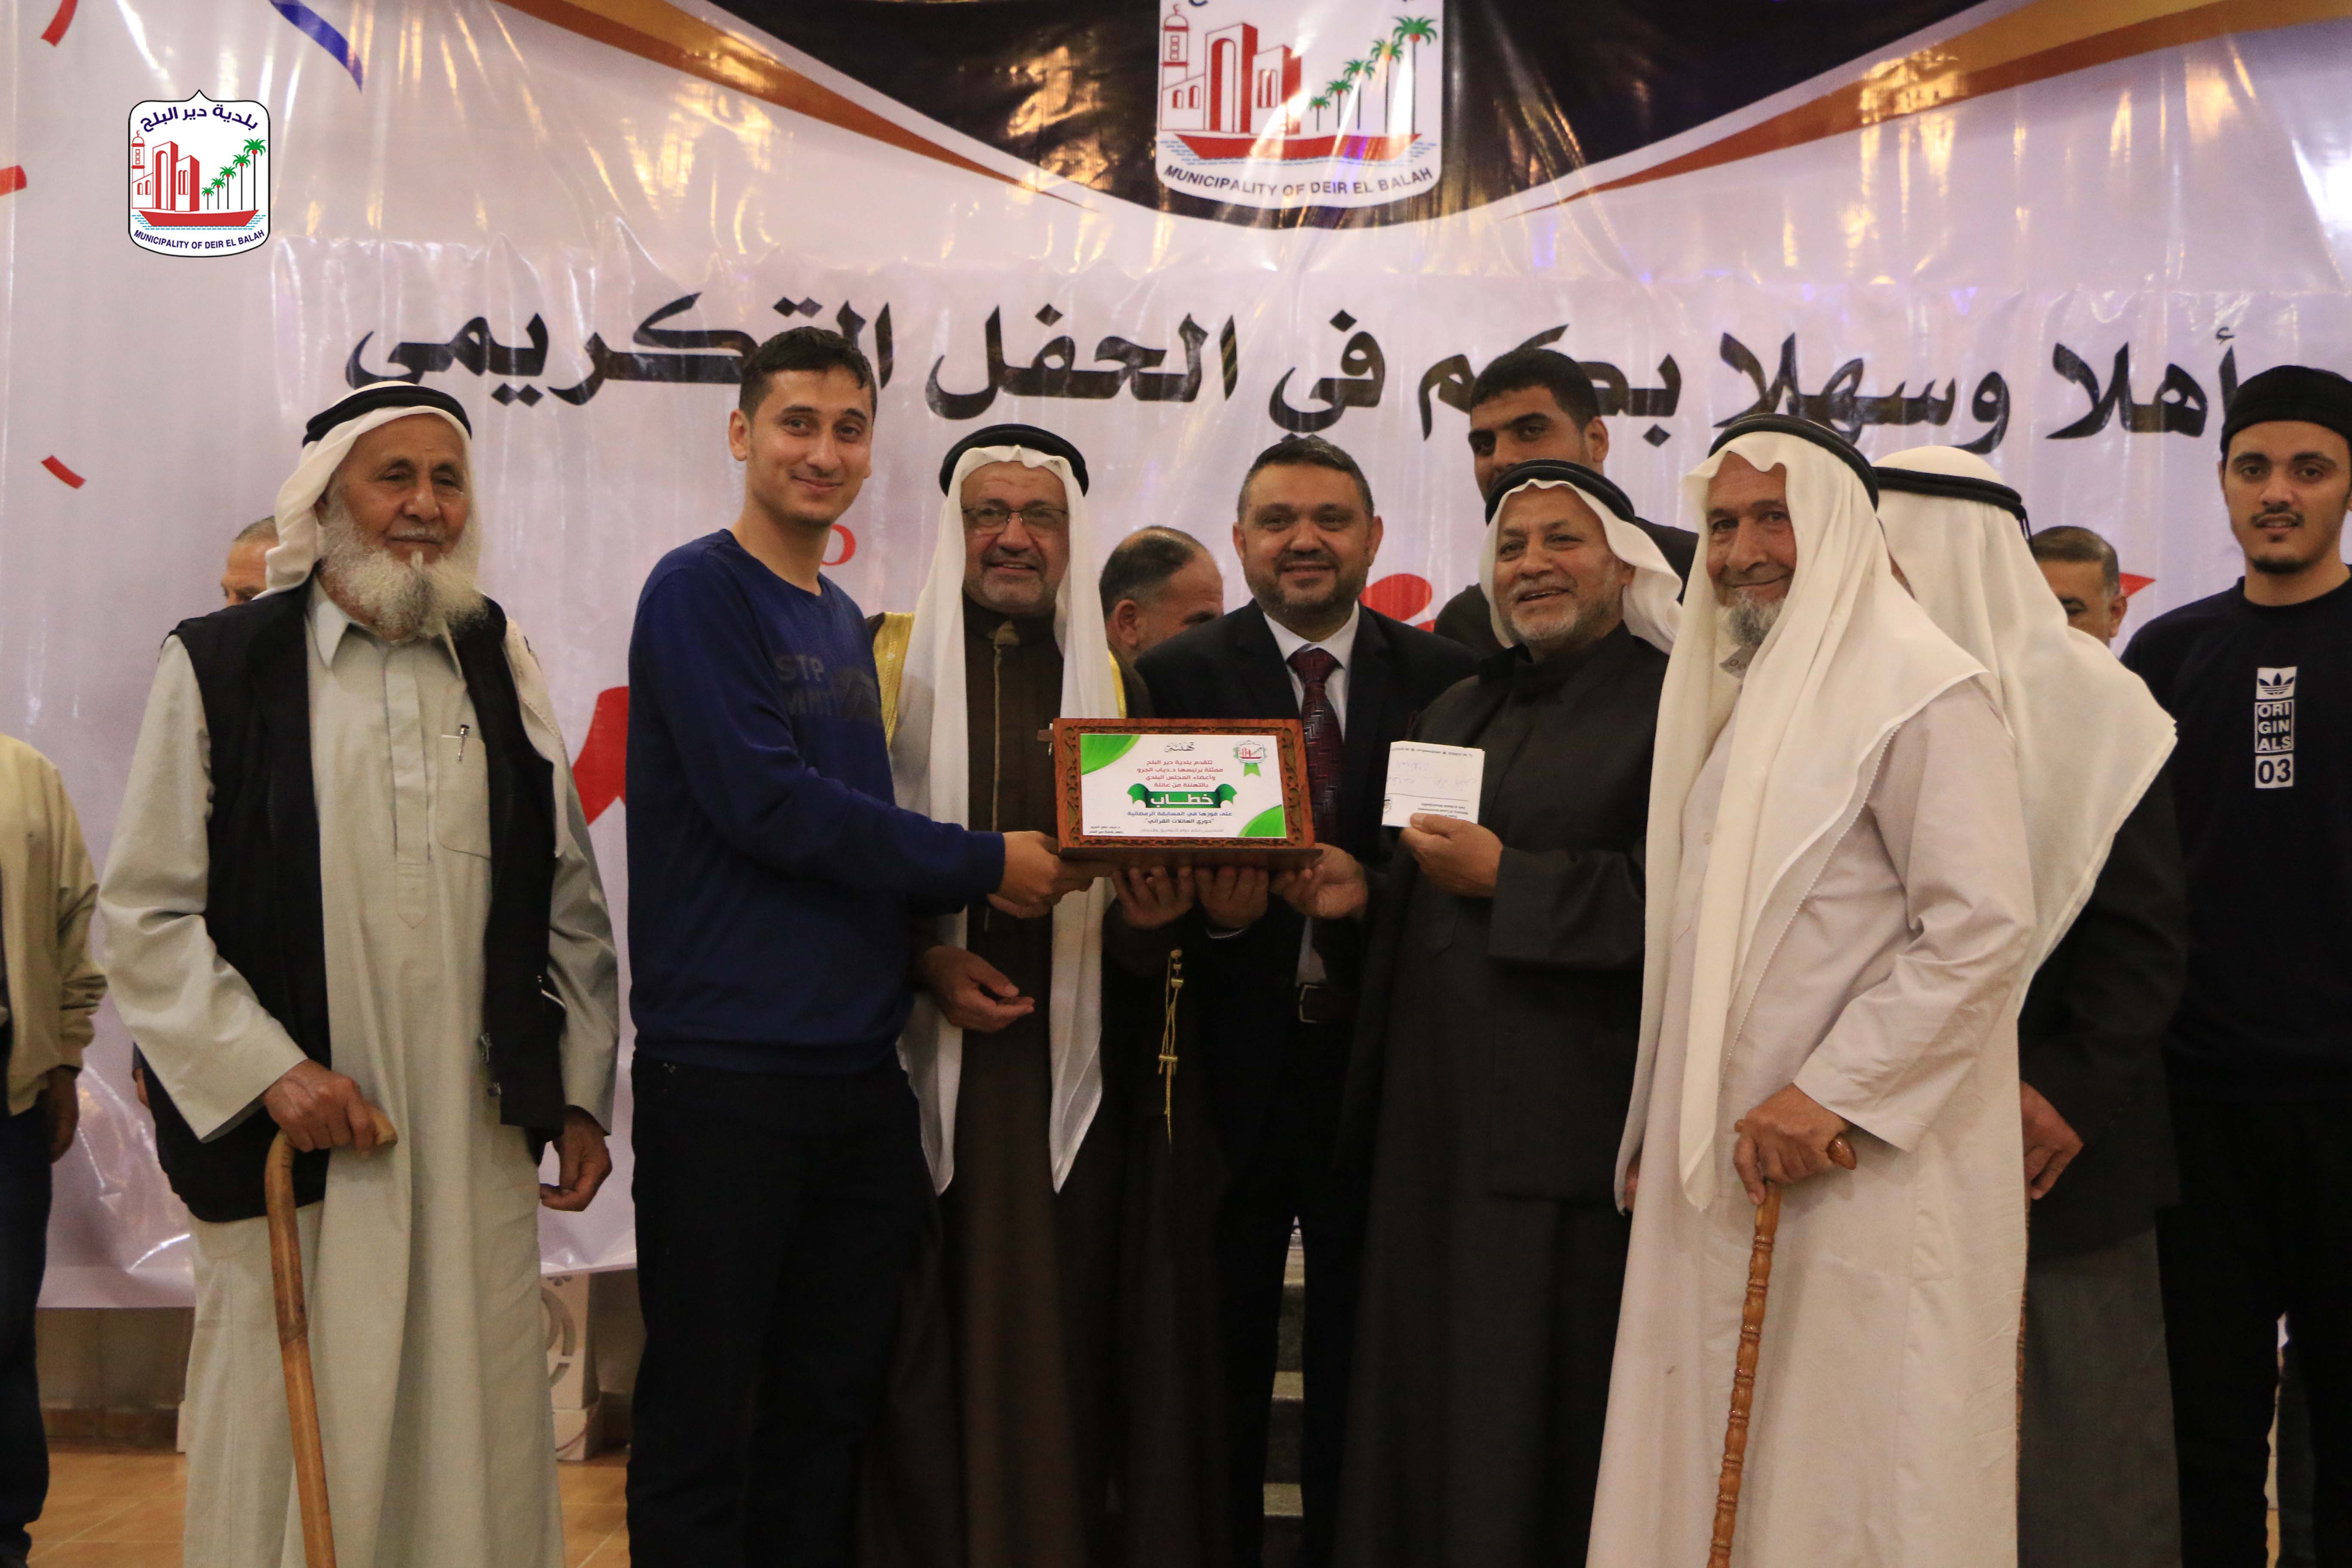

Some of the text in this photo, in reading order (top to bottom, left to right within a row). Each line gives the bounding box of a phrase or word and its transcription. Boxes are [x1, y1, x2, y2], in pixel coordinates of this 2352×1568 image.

[1163, 165, 1433, 197] MUNICIPALITY OF DEIR EL BALAH
[925, 303, 1238, 421] الحفل
[1713, 331, 2010, 454] وسهلا
[2257, 702, 2291, 718] ORI
[2258, 719, 2290, 734] GIN
[2258, 737, 2291, 751] ALS
[2258, 759, 2291, 784] 03
